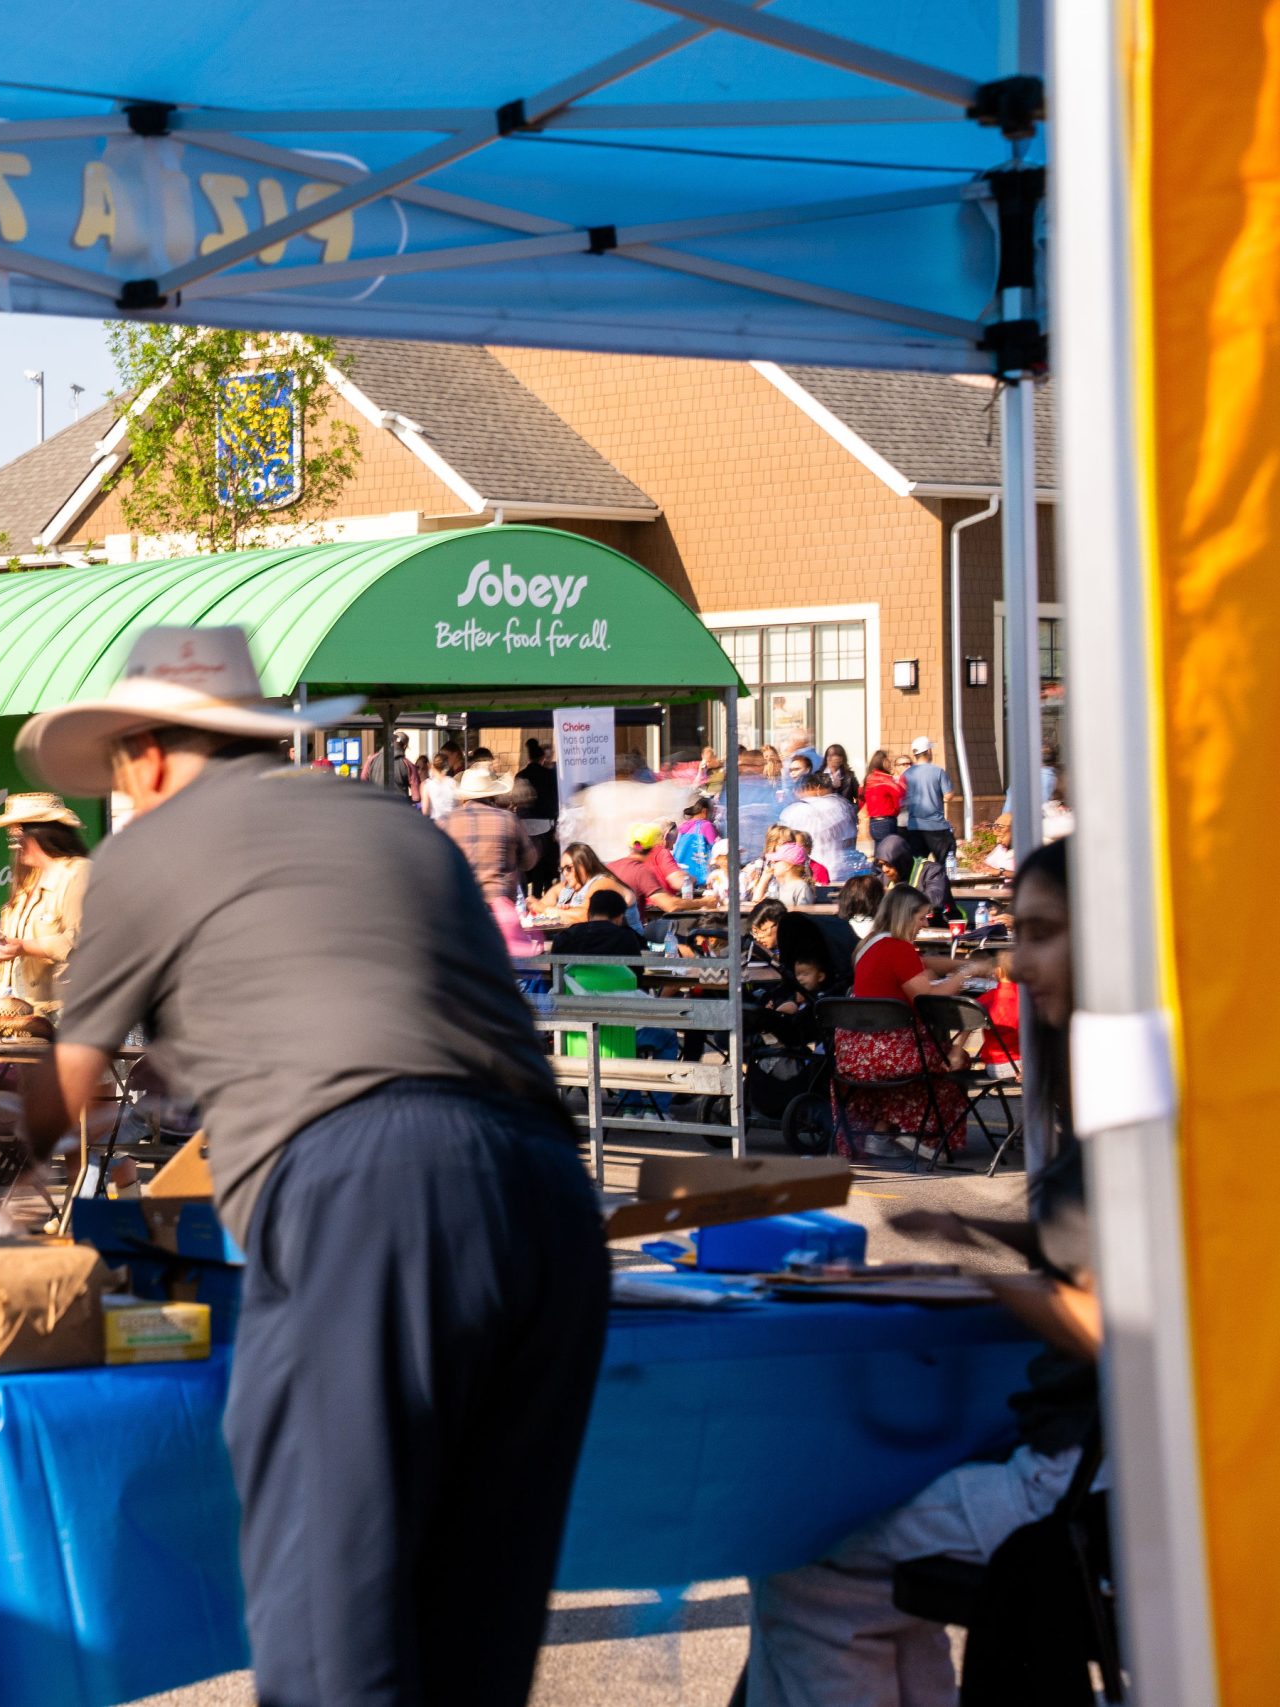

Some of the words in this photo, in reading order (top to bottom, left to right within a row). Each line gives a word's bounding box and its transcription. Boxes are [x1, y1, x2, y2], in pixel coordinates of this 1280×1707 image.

[457, 560, 588, 615] Sobeys
[435, 617, 500, 652] Better
[502, 617, 541, 654] food
[546, 619, 578, 657] for
[579, 618, 612, 651] all.
[562, 722, 591, 732] Choice
[563, 736, 578, 744] has
[586, 732, 609, 745] place
[563, 746, 581, 755] with
[582, 746, 600, 756] your
[564, 758, 588, 767] name
[589, 757, 599, 766] on
